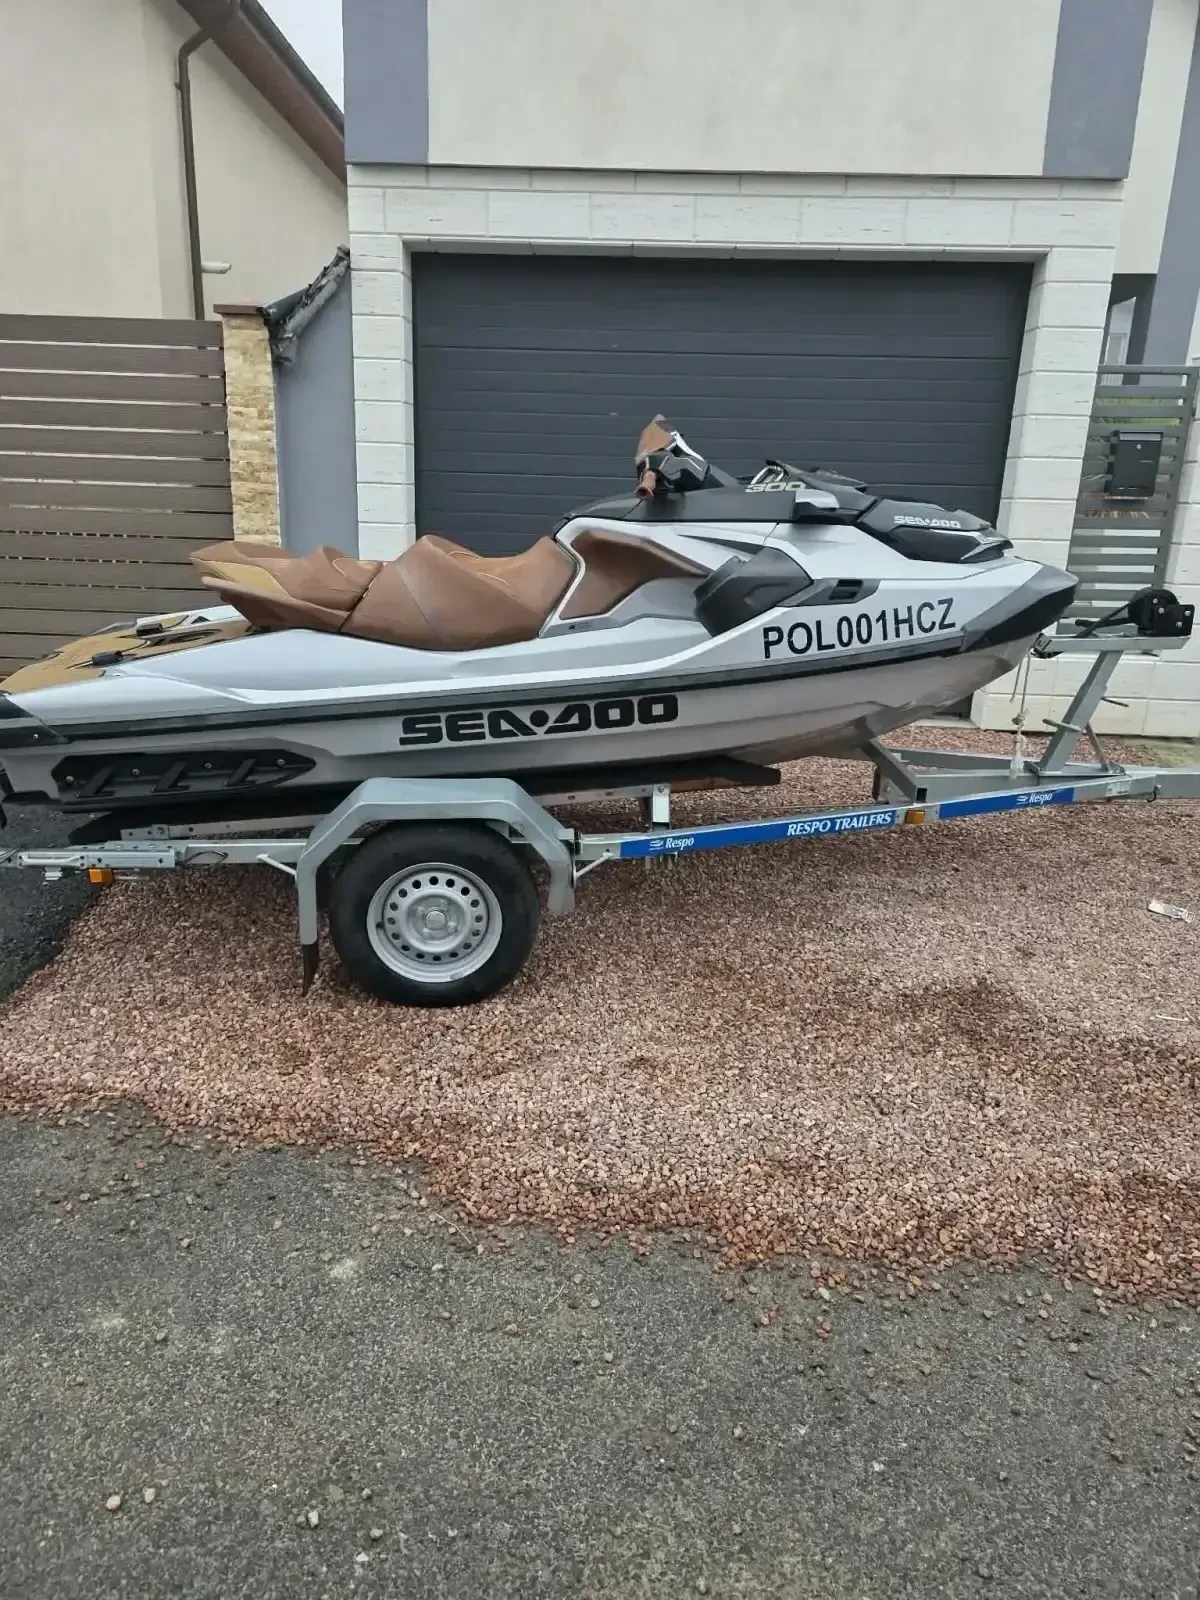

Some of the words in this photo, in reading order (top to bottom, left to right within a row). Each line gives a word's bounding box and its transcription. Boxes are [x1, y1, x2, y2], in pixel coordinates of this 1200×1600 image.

[745, 482, 806, 493] 300
[763, 597, 956, 659] POL001HCZ
[1029, 792, 1053, 805] Respo
[787, 820, 831, 836] RESPO
[835, 812, 891, 830] TRAILERS
[665, 836, 694, 850] Respo
